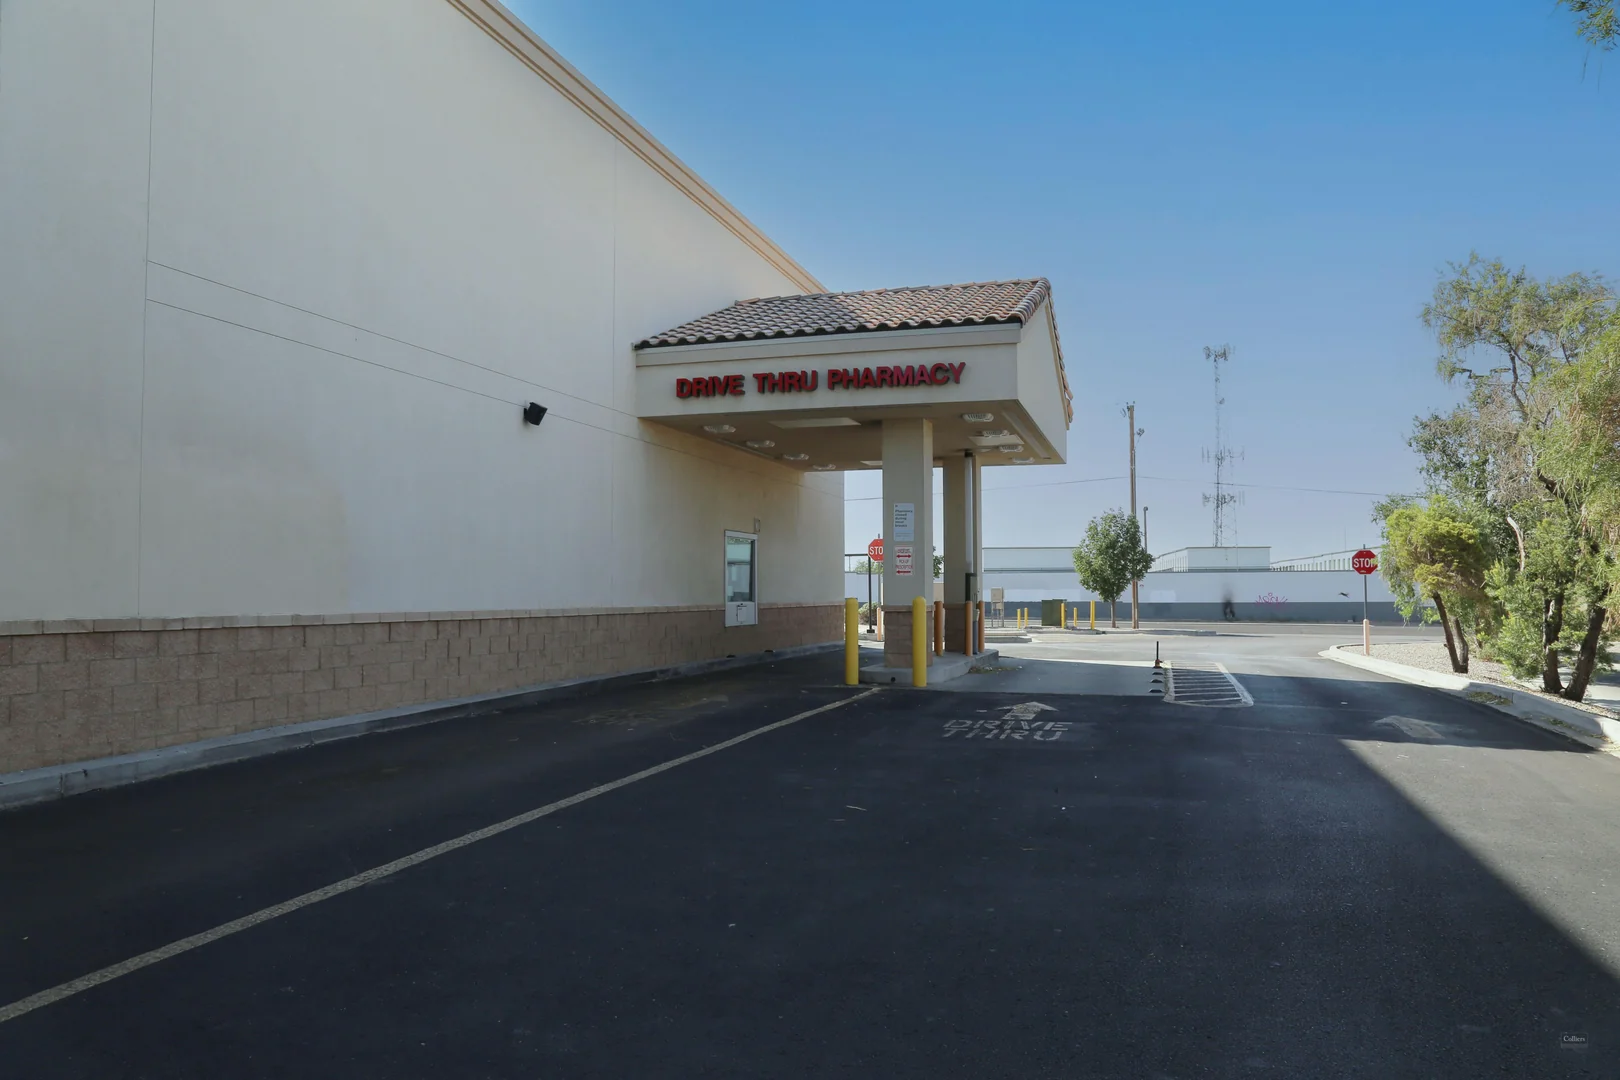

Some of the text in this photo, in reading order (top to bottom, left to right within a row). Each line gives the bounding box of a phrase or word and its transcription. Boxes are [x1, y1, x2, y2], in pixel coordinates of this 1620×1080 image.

[676, 362, 966, 398] DRIVE THRU PHARMACY
[869, 546, 883, 555] STO
[942, 720, 1073, 731] DRIVE
[942, 727, 1062, 741] THRU
